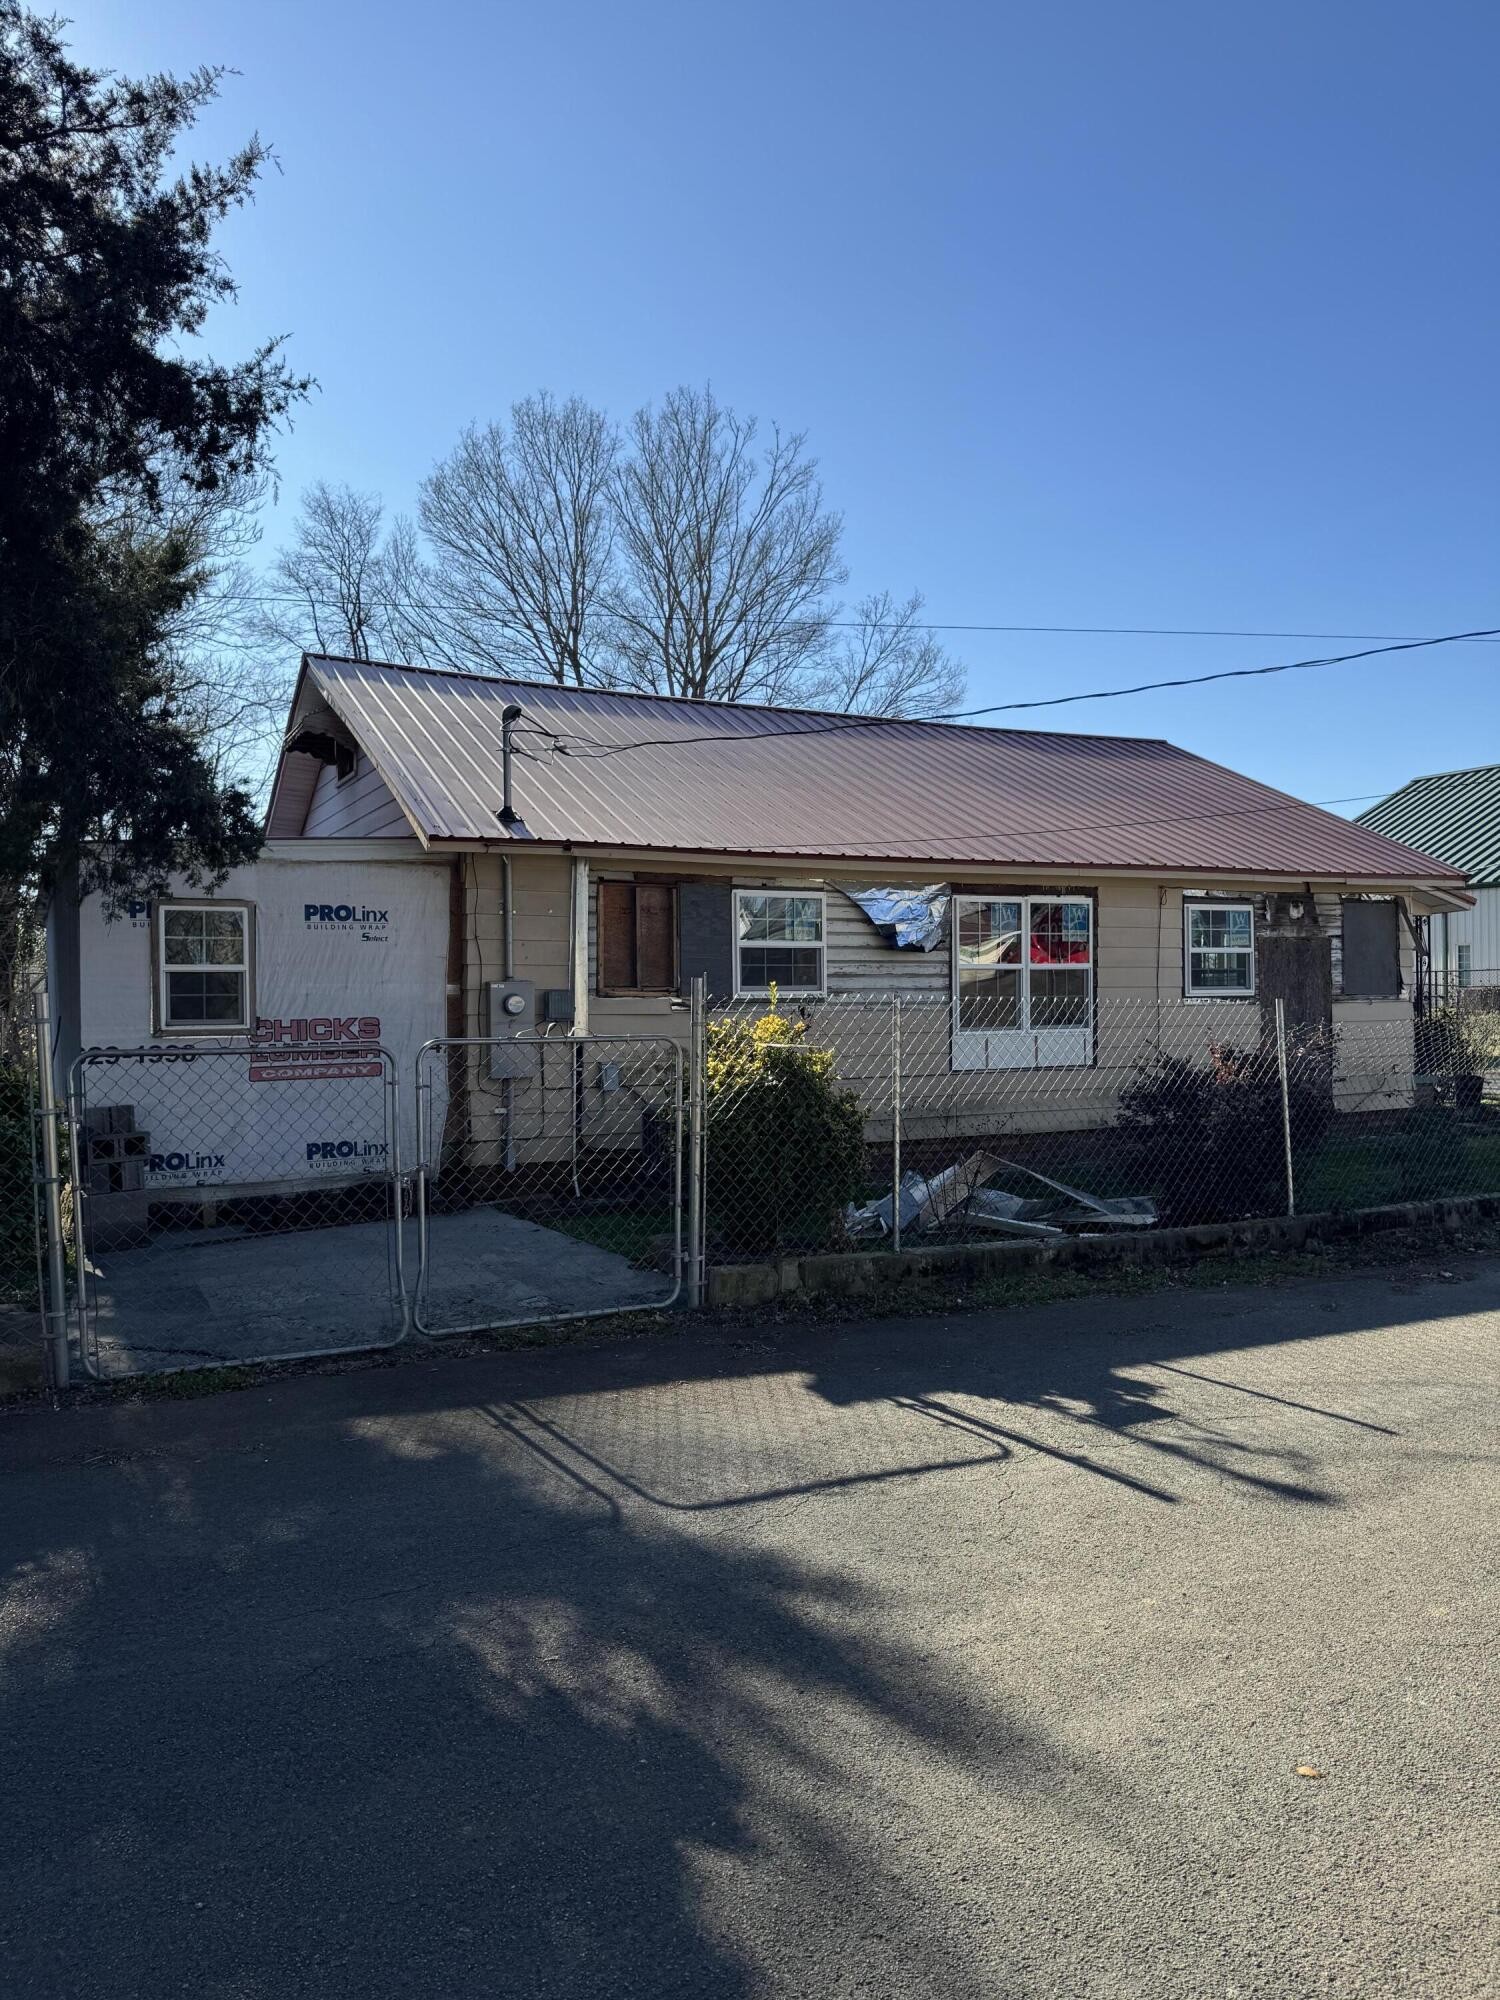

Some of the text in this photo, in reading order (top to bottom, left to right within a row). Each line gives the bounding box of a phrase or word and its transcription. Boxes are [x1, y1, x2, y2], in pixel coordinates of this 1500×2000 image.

[304, 904, 388, 922] PROLinx
[991, 905, 1016, 926] JW
[361, 932, 388, 942] Select
[250, 1017, 380, 1042] CHICKS
[250, 1041, 381, 1062] LUMBER
[261, 1066, 370, 1078] COMPANY
[306, 1140, 389, 1160] PROLinx
